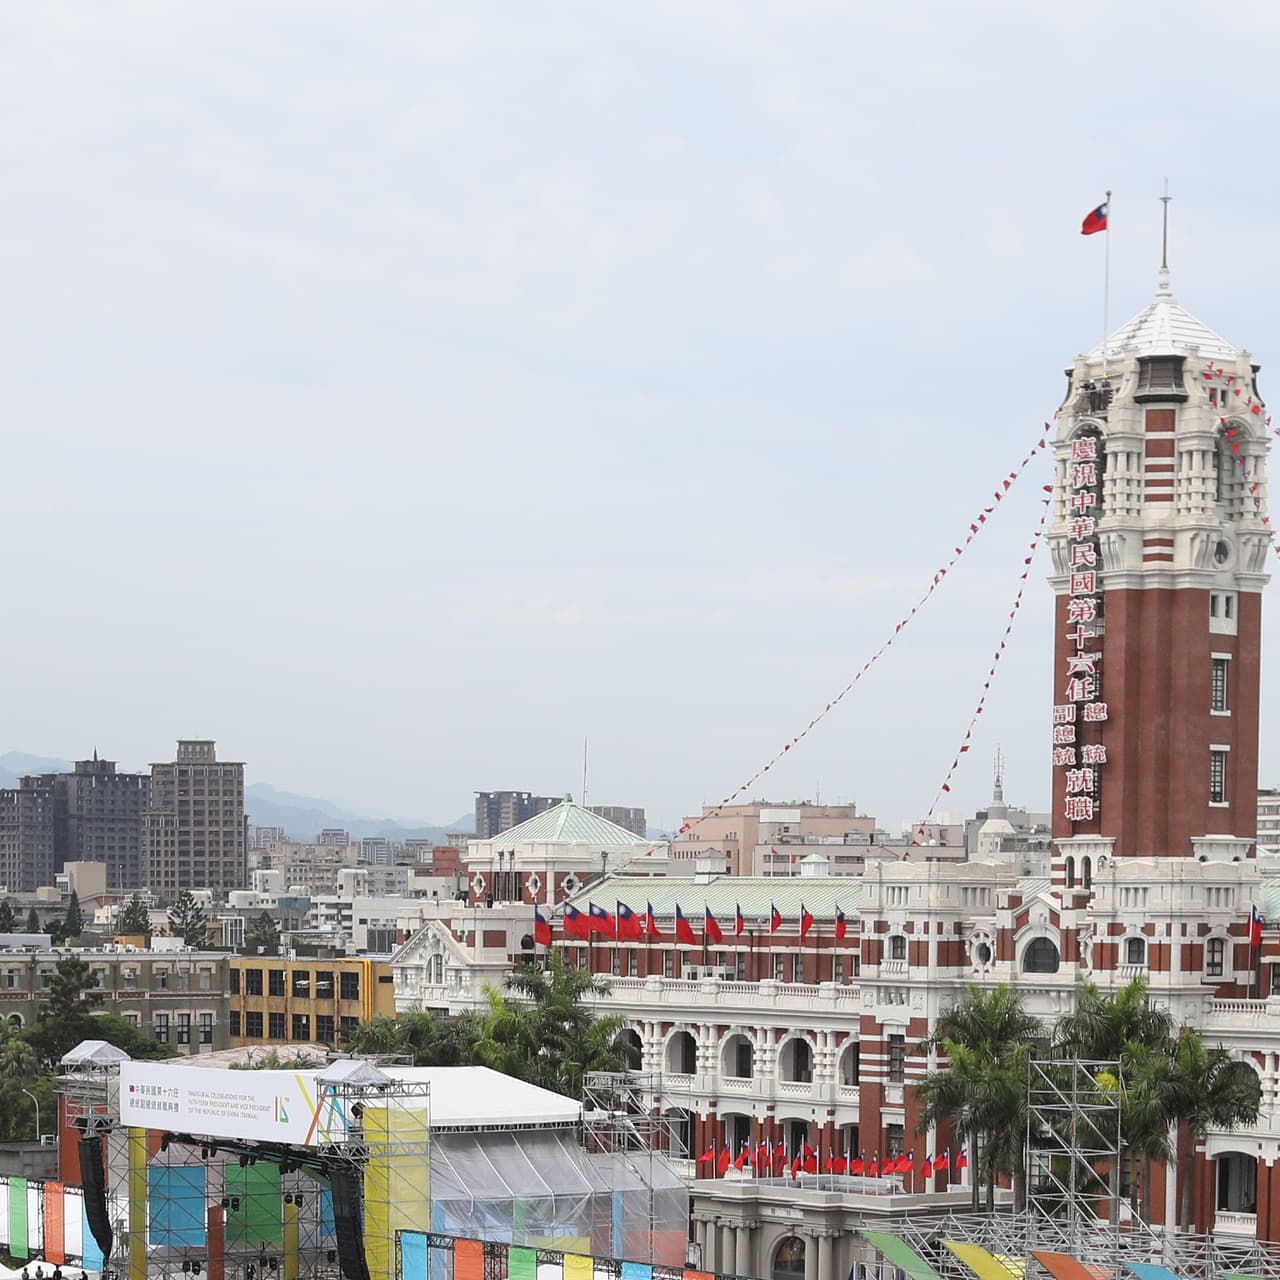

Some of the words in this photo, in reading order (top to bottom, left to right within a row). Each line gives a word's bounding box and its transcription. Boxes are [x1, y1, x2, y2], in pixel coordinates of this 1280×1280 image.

[1066, 437, 1097, 702] 慶祝中華民國第十六任
[1053, 703, 1076, 766] 副總統
[1082, 702, 1108, 764] 總統
[1064, 768, 1094, 821] 就職
[135, 1085, 179, 1098] 中華民國第十六任
